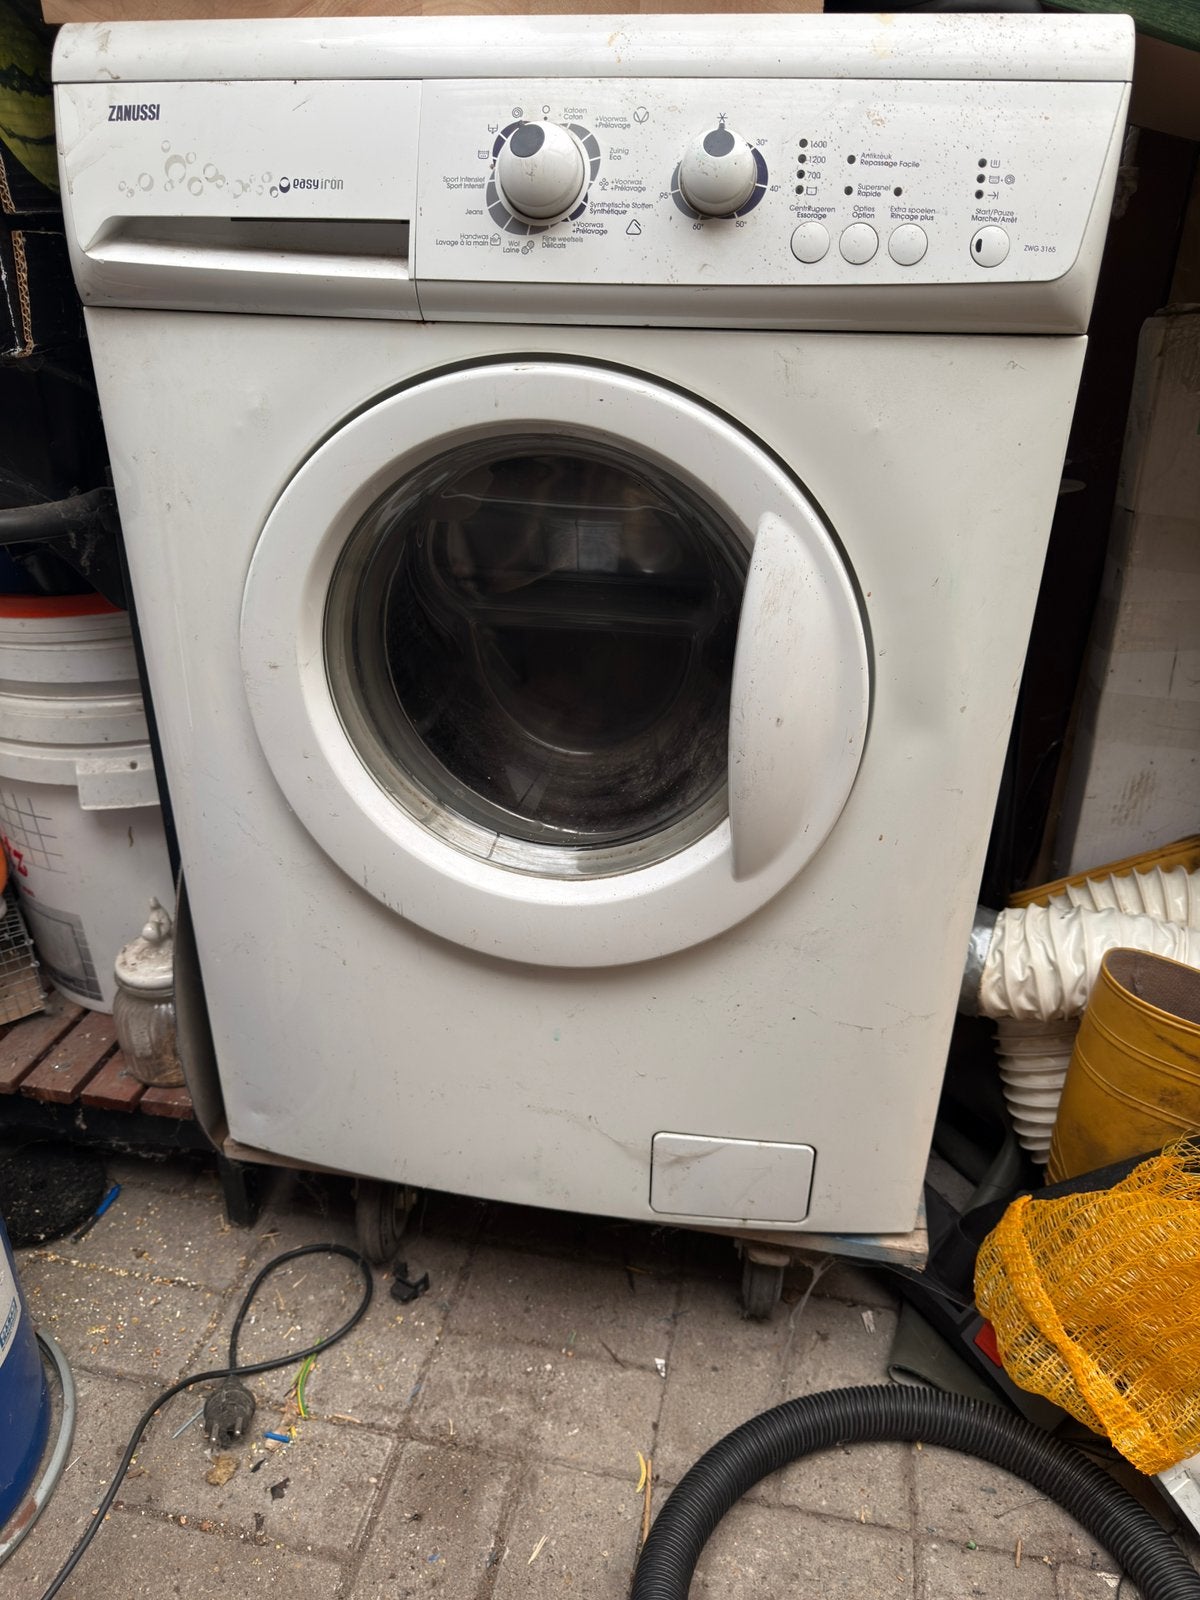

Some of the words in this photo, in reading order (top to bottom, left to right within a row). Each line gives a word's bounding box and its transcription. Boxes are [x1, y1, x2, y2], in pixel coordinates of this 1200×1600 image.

[108, 104, 160, 122] ZANUSSI
[808, 156, 826, 164] 1200
[860, 160, 898, 168] Repassage
[857, 183, 891, 192] Supersnel
[590, 202, 630, 210] Synthetische
[789, 205, 836, 213] Centrifugeren
[853, 205, 875, 213] Opties
[975, 208, 1014, 217] Start/Pauze
[890, 213, 919, 221] Rinçage
[971, 215, 1018, 223] Marche/Arrêt
